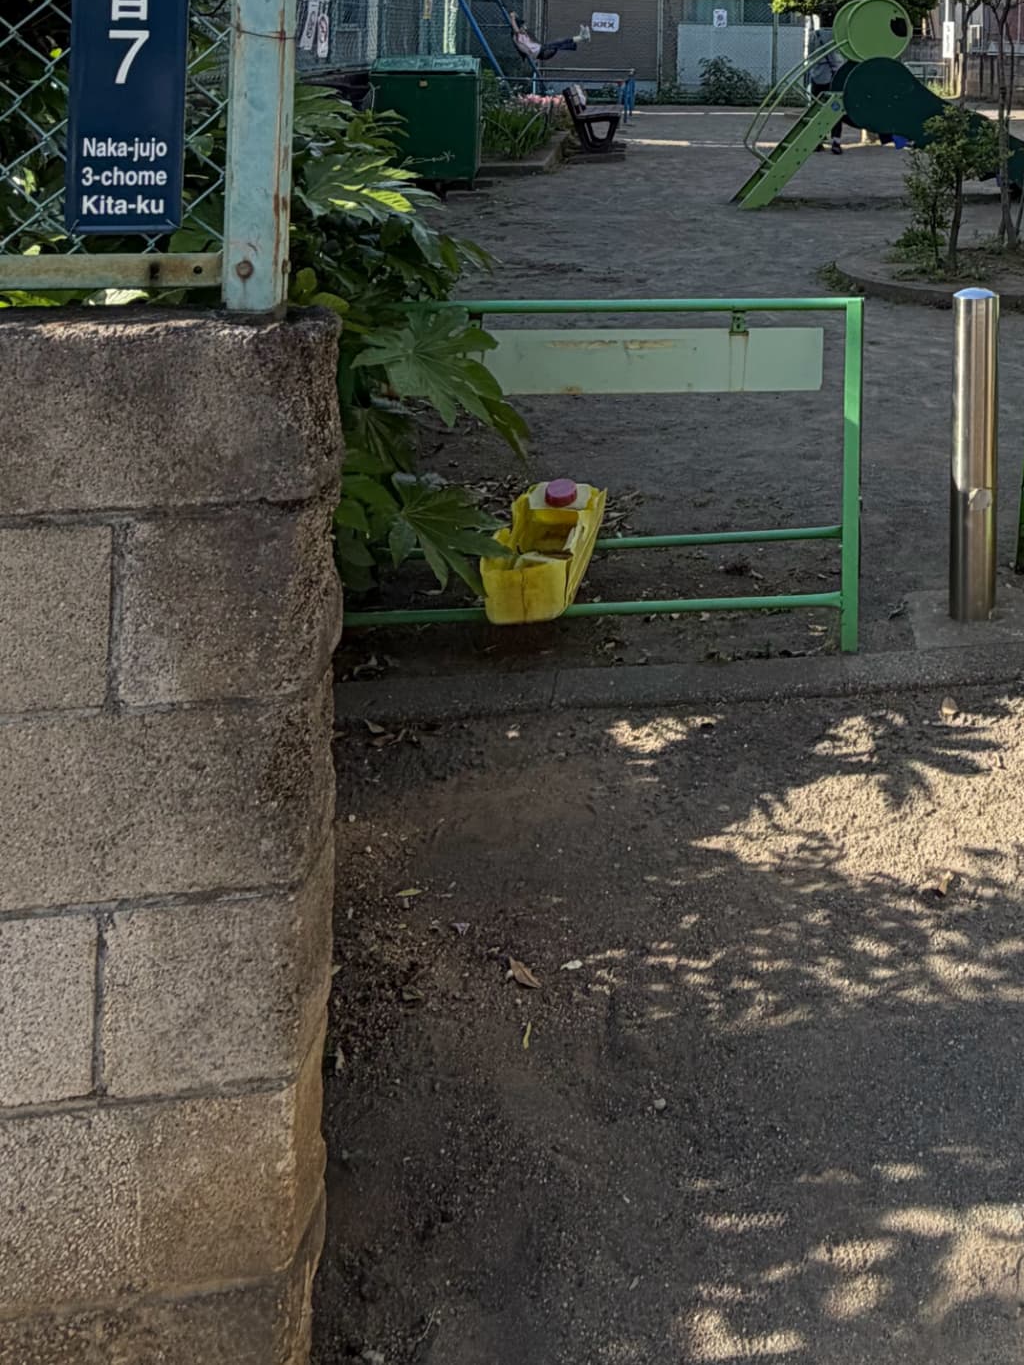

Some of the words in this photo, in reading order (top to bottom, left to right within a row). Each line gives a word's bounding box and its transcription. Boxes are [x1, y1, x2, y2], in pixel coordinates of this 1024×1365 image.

[82, 137, 168, 162] Naka-jujo
[81, 166, 168, 186] 3-chome
[82, 194, 165, 215] Kita-ku
